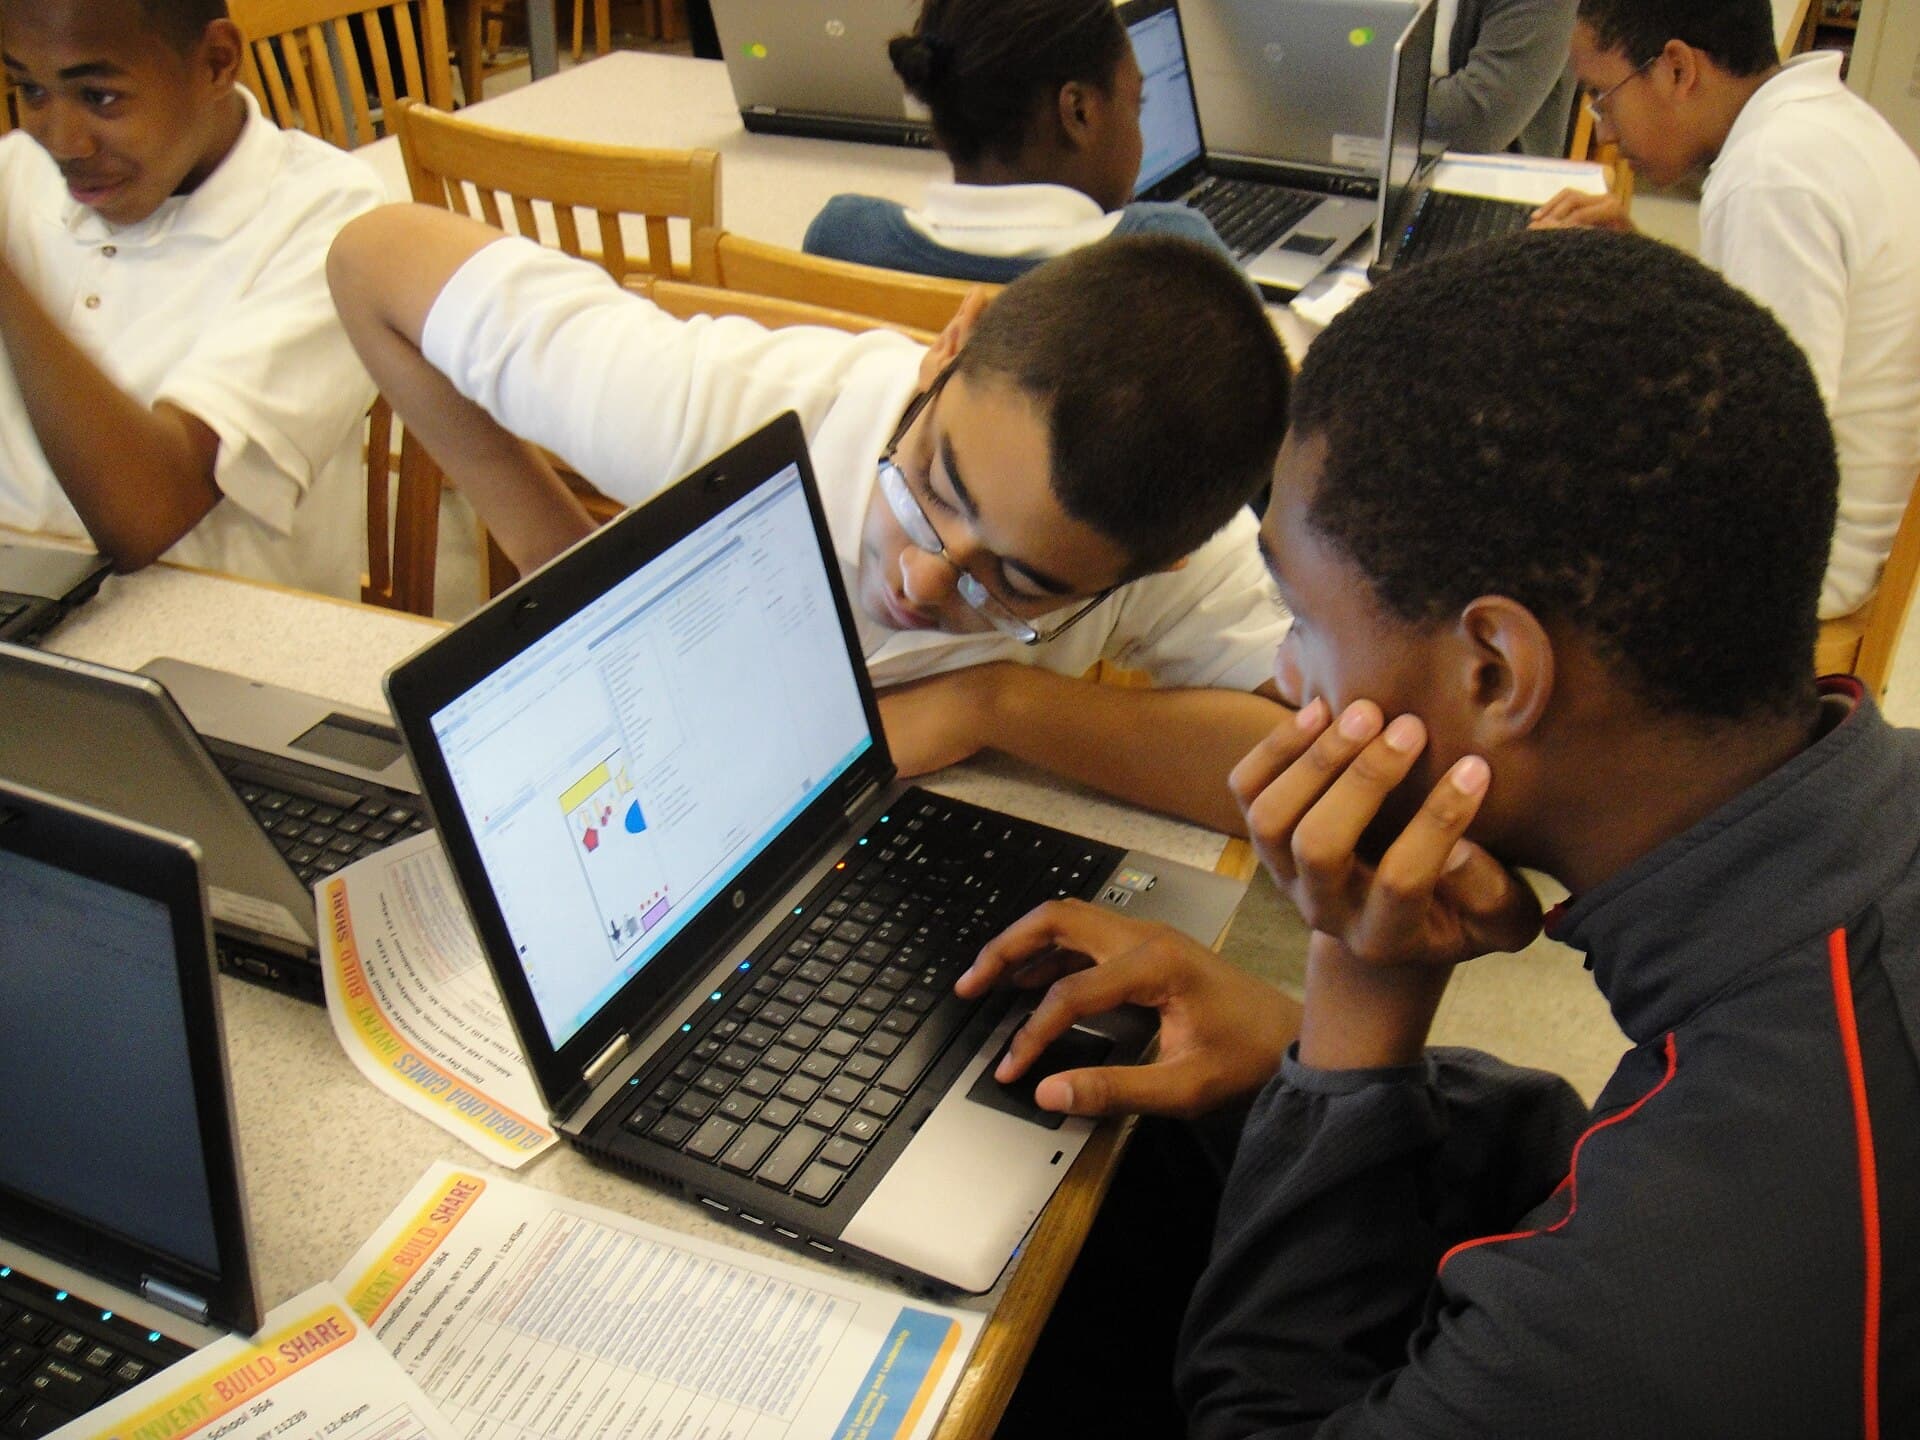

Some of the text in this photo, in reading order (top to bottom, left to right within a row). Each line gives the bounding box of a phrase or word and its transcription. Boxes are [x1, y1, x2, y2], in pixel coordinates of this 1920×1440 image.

[371, 978, 391, 1010] School
[332, 891, 543, 1152] GLOBALORIA GAMES INVENT BUILD SHARE
[392, 1225, 438, 1265] BUILD
[430, 1179, 477, 1222] SHARE
[409, 1268, 434, 1296] School
[214, 1353, 277, 1403] BUILD
[279, 1314, 346, 1365] SHARE
[207, 1397, 273, 1440] School 364
[274, 1409, 307, 1434] 11239
[323, 1402, 370, 1434] 12:45pm
